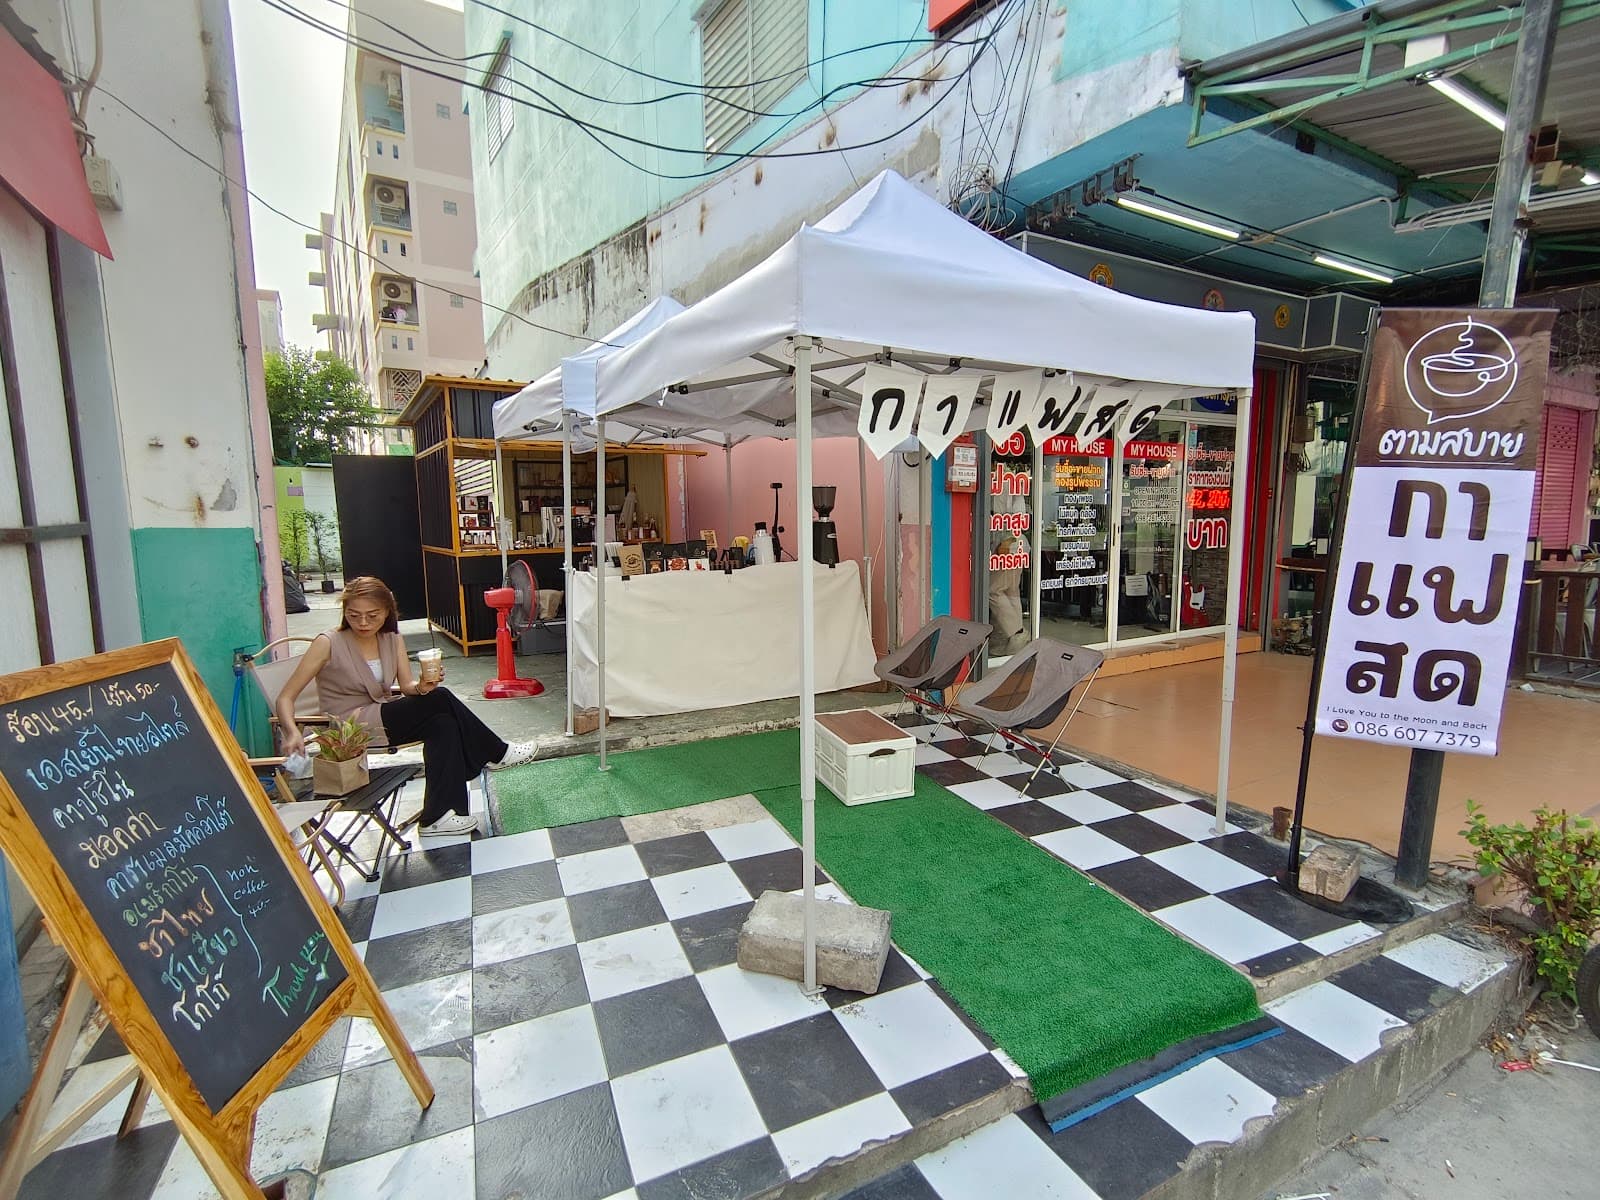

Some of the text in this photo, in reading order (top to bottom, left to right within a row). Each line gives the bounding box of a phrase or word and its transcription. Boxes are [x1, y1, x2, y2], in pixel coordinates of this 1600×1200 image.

[1051, 439, 1069, 452] MY
[1130, 444, 1177, 458] MY HOUSE
[1378, 427, 1524, 458] ตามสบาย
[1388, 479, 1491, 541] กา
[1187, 518, 1228, 550] บาท
[1346, 640, 1482, 706] สด
[1332, 706, 1355, 716] Love
[1358, 709, 1377, 718] You
[1380, 712, 1390, 720] to
[1393, 713, 1409, 722] the
[1412, 716, 1438, 726] Moon
[1441, 719, 1459, 728] and
[1354, 721, 1482, 749] 086 607 7379
